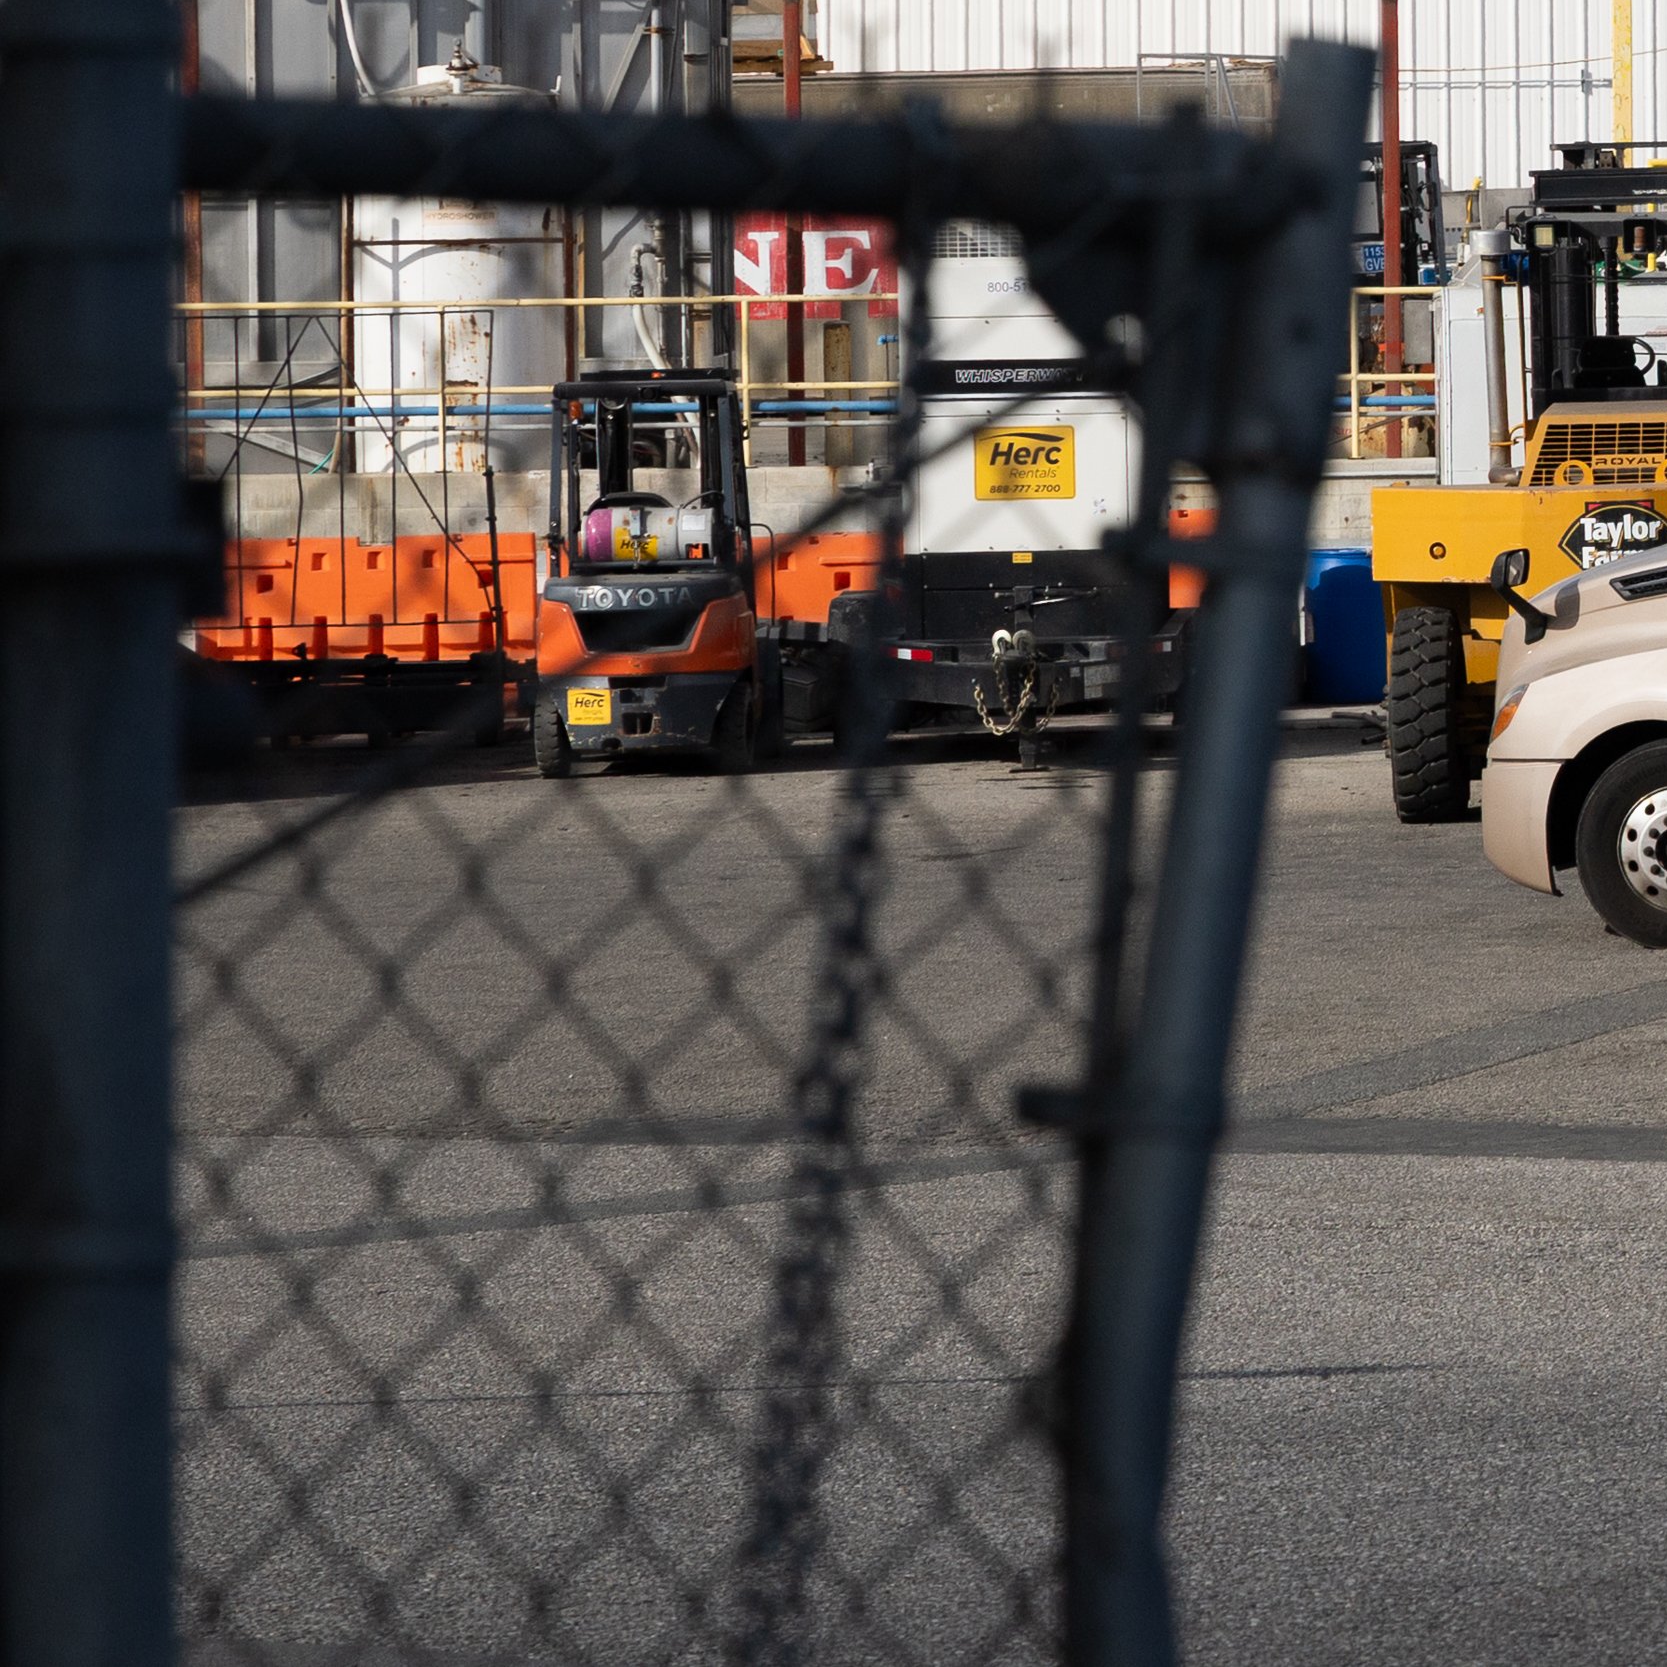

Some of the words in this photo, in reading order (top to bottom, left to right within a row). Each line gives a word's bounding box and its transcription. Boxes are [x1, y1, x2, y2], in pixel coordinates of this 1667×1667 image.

[955, 368, 1074, 384] WHISPERWA
[990, 442, 1062, 465] Herc
[1595, 457, 1662, 466] ROYAL
[1009, 467, 1057, 478] Rentals
[989, 484, 1061, 494] 888-777-2700
[1580, 514, 1663, 548] Taylor
[1582, 546, 1645, 569] Far
[576, 587, 694, 609] TOYOTA
[574, 697, 605, 708] Herc
